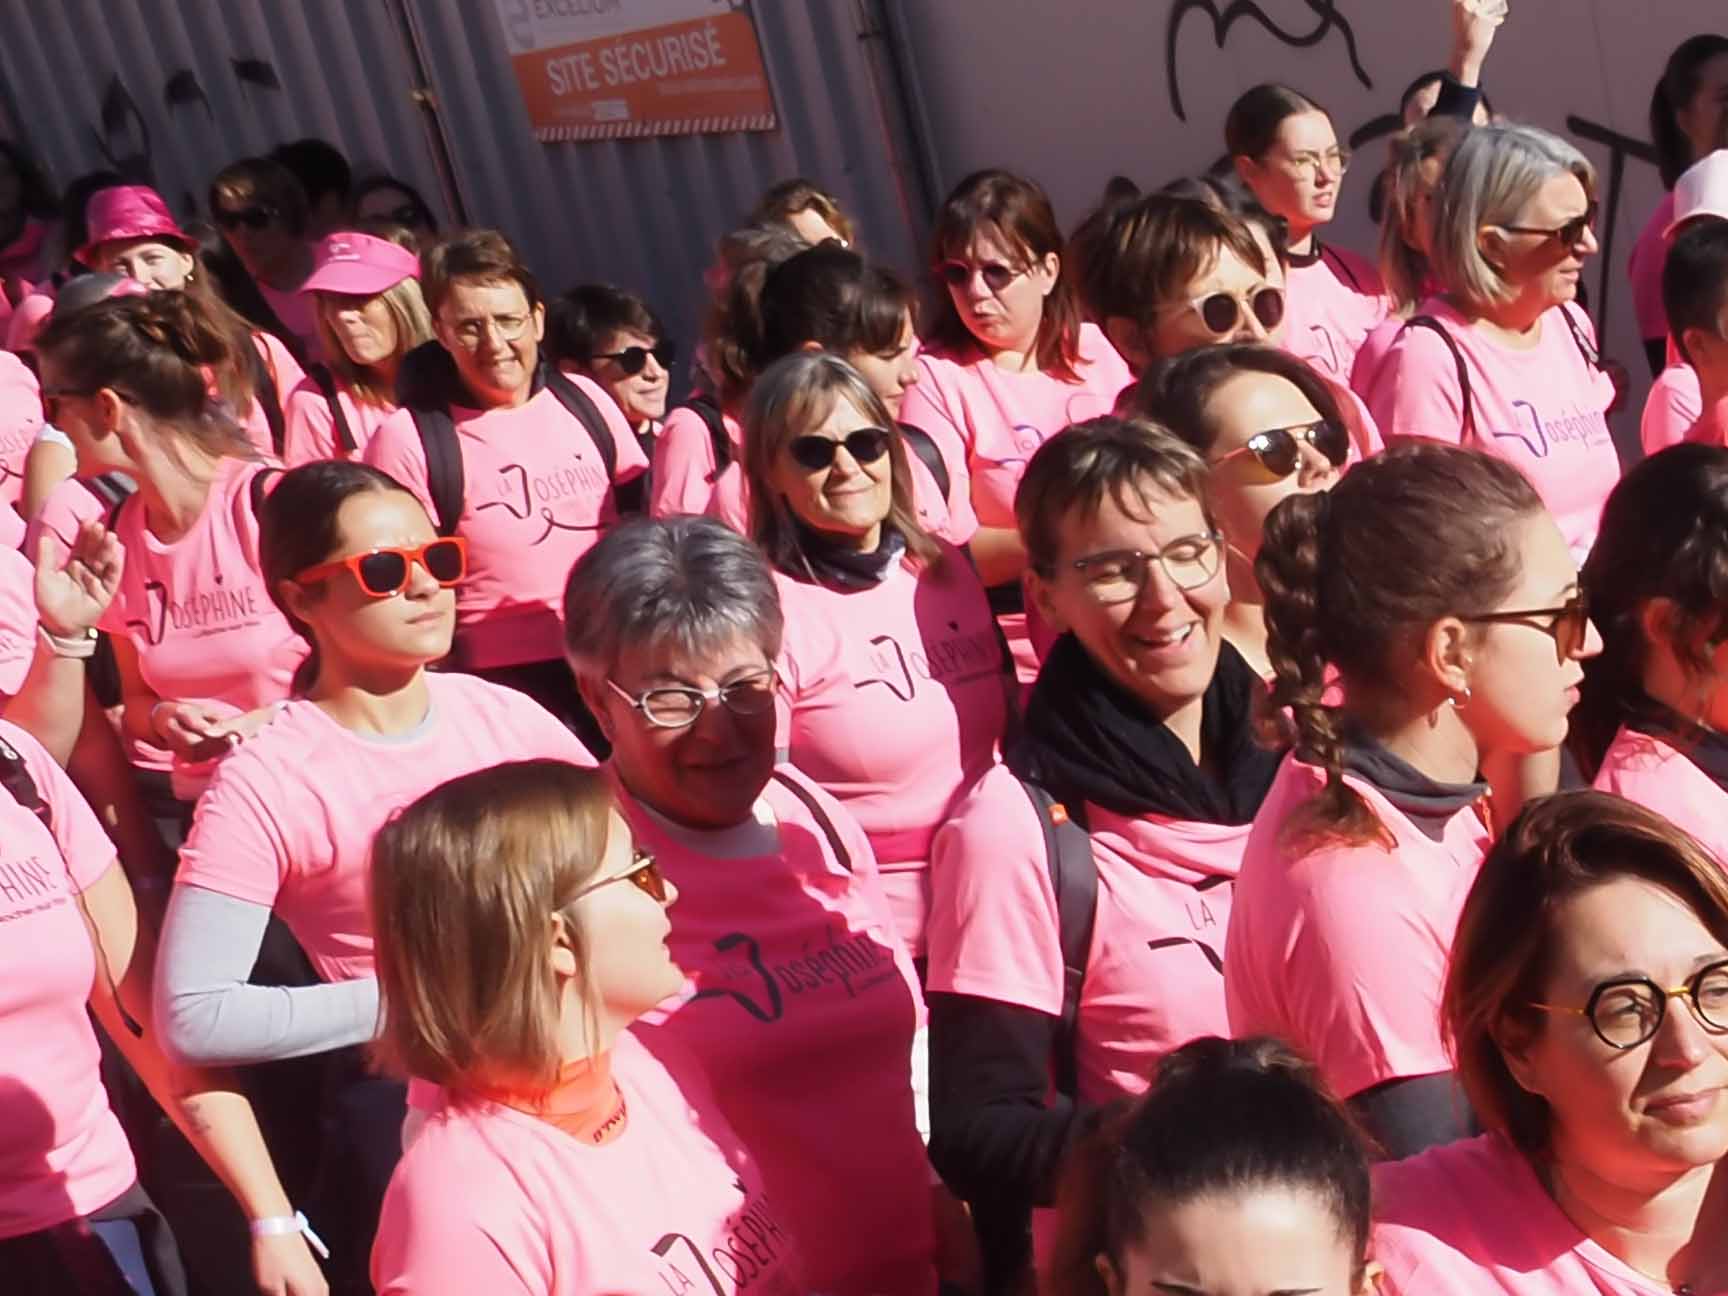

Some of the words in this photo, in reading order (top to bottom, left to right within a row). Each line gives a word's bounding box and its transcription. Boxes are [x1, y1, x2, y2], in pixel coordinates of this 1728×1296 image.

[545, 53, 601, 97] SITE
[599, 20, 726, 87] SÉCURISÉ
[1184, 898, 1217, 931] LA
